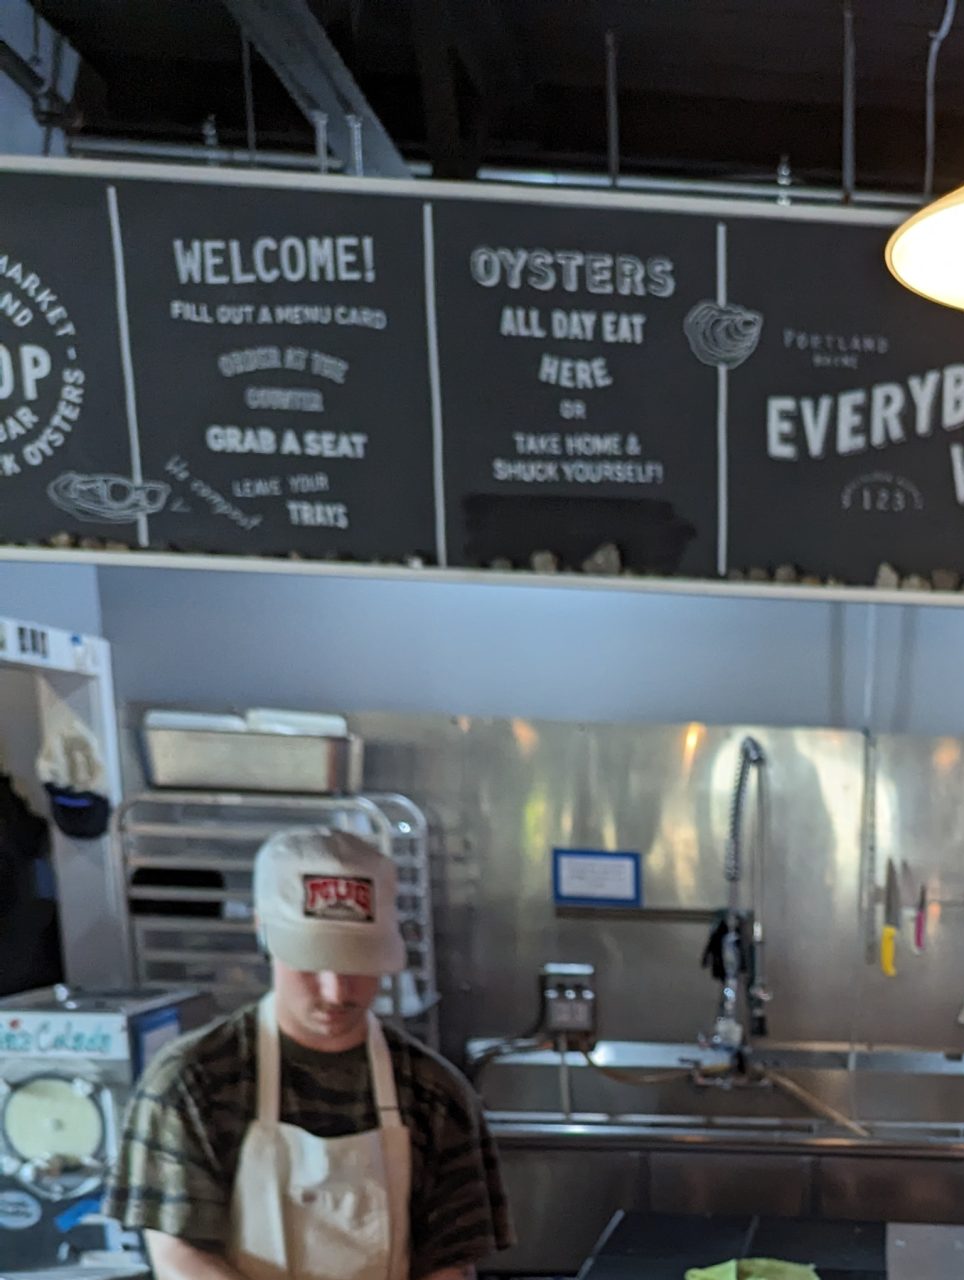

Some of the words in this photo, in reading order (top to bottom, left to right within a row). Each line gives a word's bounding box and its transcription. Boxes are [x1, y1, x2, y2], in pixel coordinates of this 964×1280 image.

[172, 236, 376, 285] WELCOME!
[470, 246, 676, 298] OYSTERS
[170, 299, 214, 323] FILL
[216, 304, 254, 324] OUT
[257, 304, 273, 324] A
[275, 304, 332, 325] MENU
[334, 304, 387, 330] CARD
[500, 305, 546, 338] ALL
[551, 309, 596, 341] DAY
[602, 310, 646, 344] EAT
[538, 353, 612, 389] HERE
[22, 368, 85, 466] OYSTERS
[206, 424, 277, 454] GRAB
[280, 427, 301, 455] A
[303, 430, 368, 459] SEAT
[513, 432, 562, 455] TAKE
[565, 433, 622, 455] HOME
[287, 501, 348, 529] TRAYS
